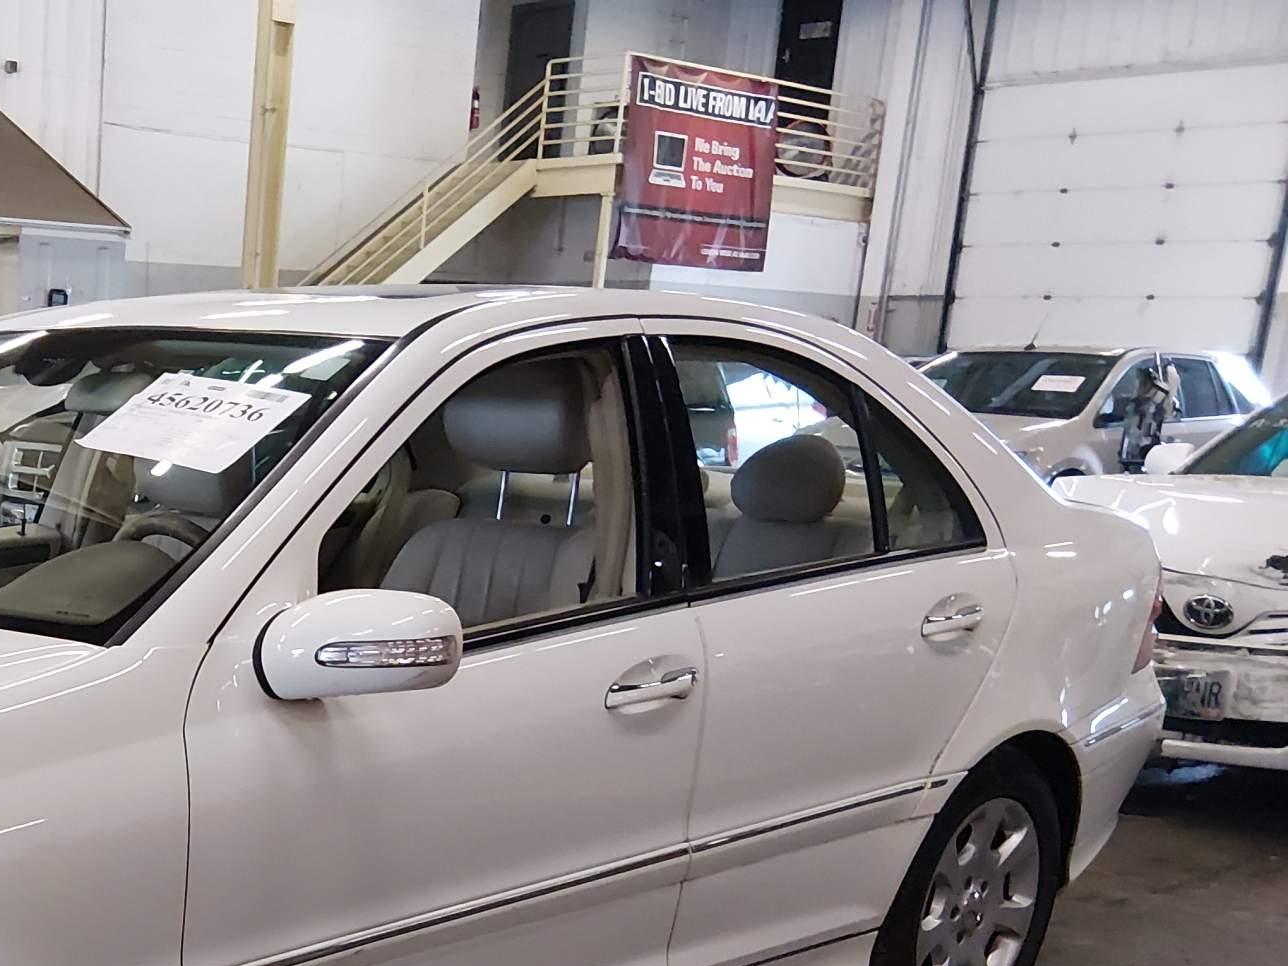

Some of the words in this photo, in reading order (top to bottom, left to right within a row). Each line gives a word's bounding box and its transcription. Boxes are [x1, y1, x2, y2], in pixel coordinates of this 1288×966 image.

[678, 85, 707, 112] LIVE
[708, 91, 747, 119] FROM
[711, 140, 740, 160] Bring
[693, 156, 712, 173] The
[713, 160, 753, 179] Auction
[691, 175, 703, 191] To
[705, 177, 724, 193] You
[147, 391, 270, 423] 45620736
